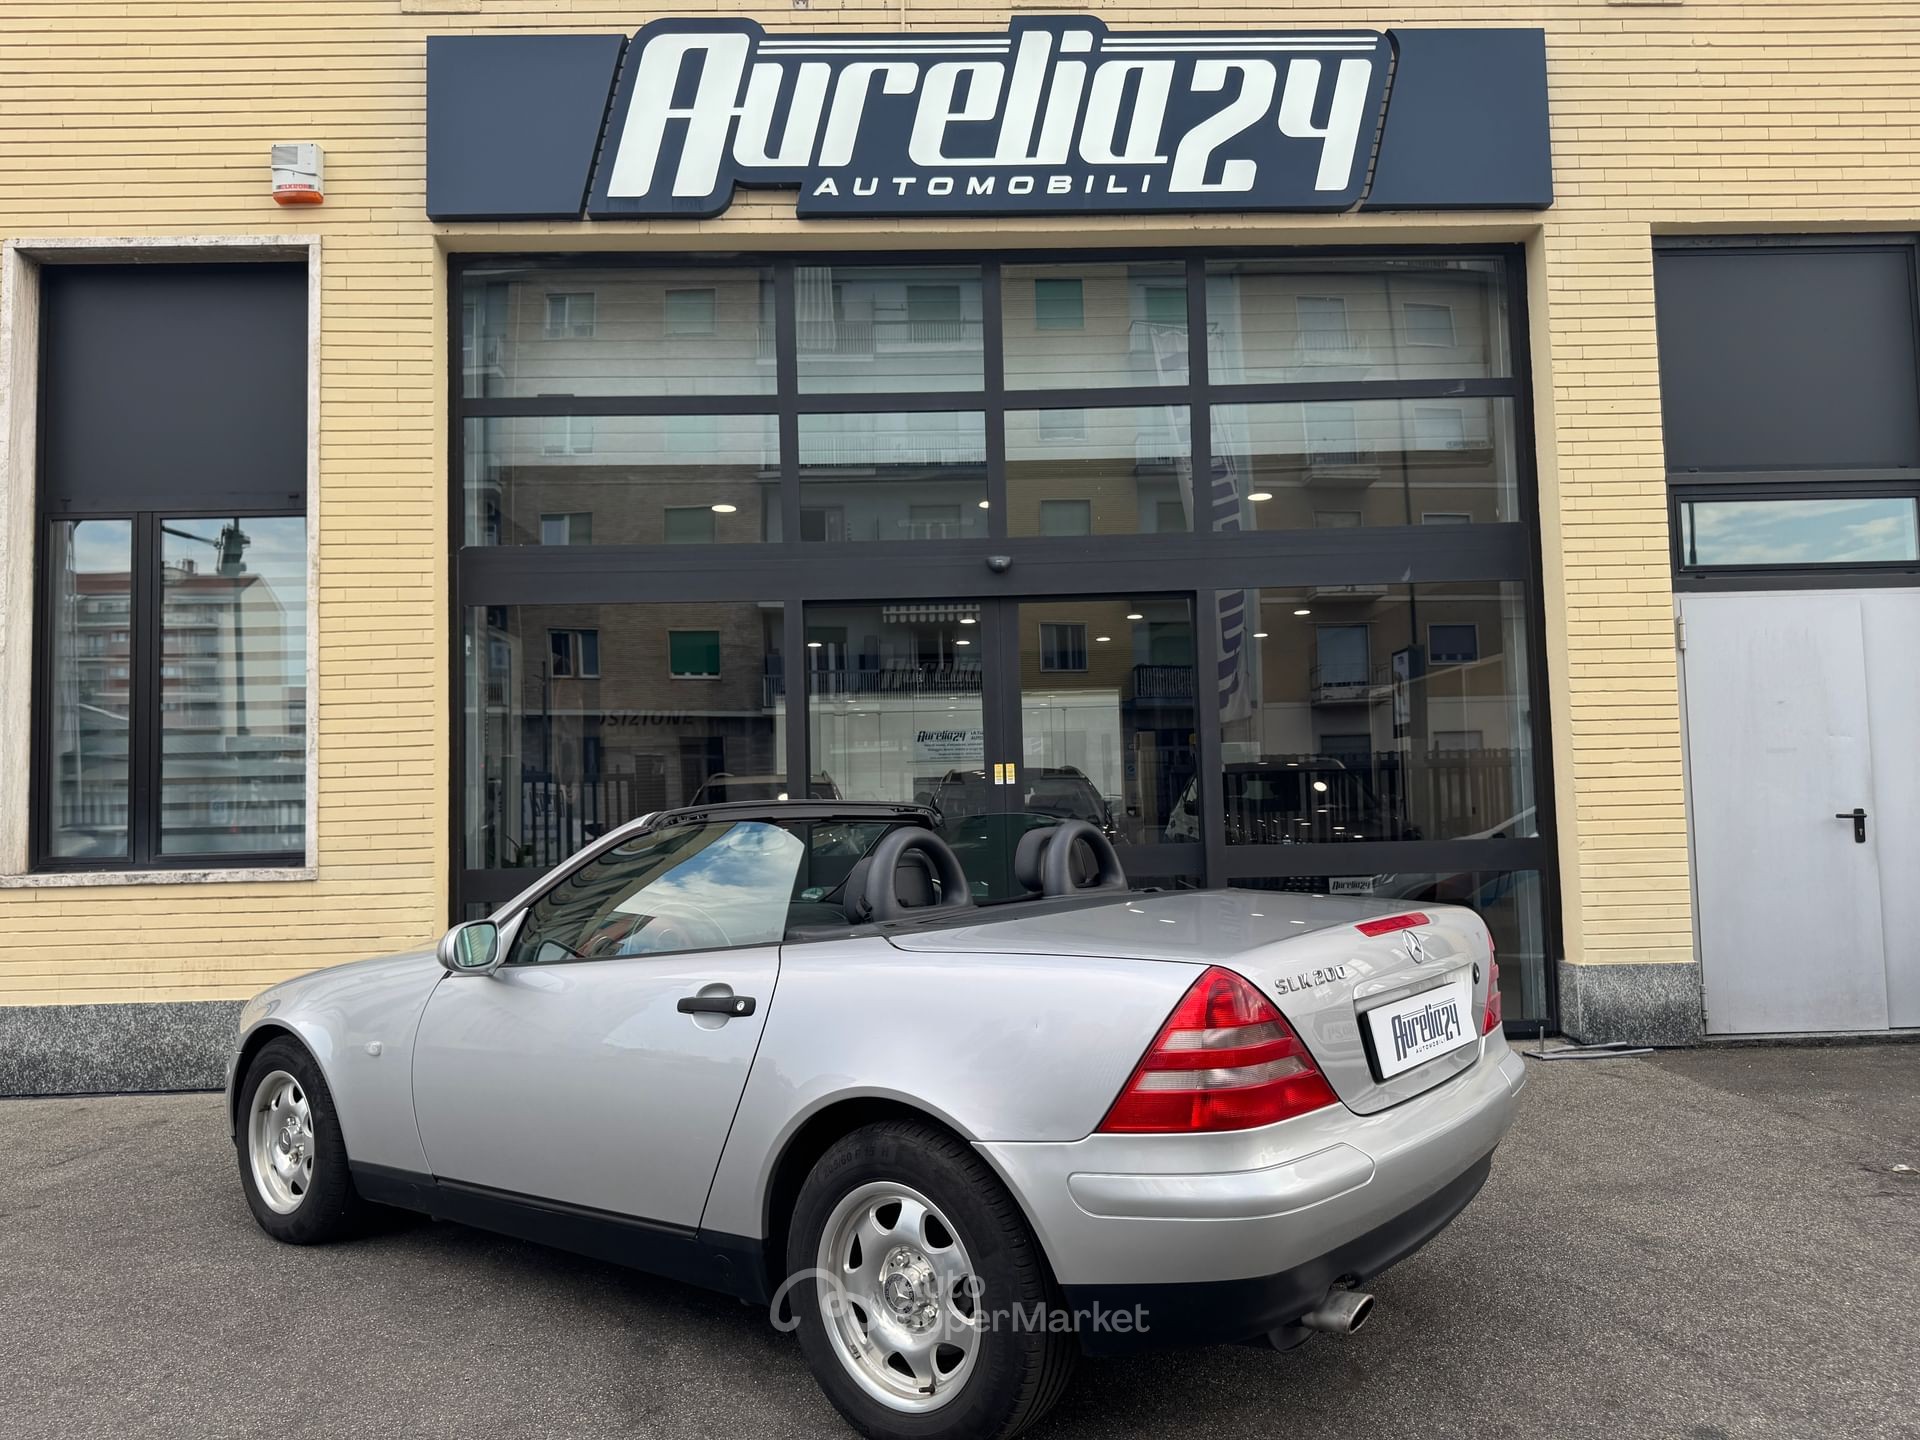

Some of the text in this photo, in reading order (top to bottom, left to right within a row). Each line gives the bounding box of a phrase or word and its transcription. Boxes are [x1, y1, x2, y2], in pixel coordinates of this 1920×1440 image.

[606, 31, 1372, 197] Aurelia24
[813, 175, 1151, 196] AUTOMOBILI
[1275, 963, 1347, 995] SLK 200
[1391, 1003, 1461, 1061] Aurelia24
